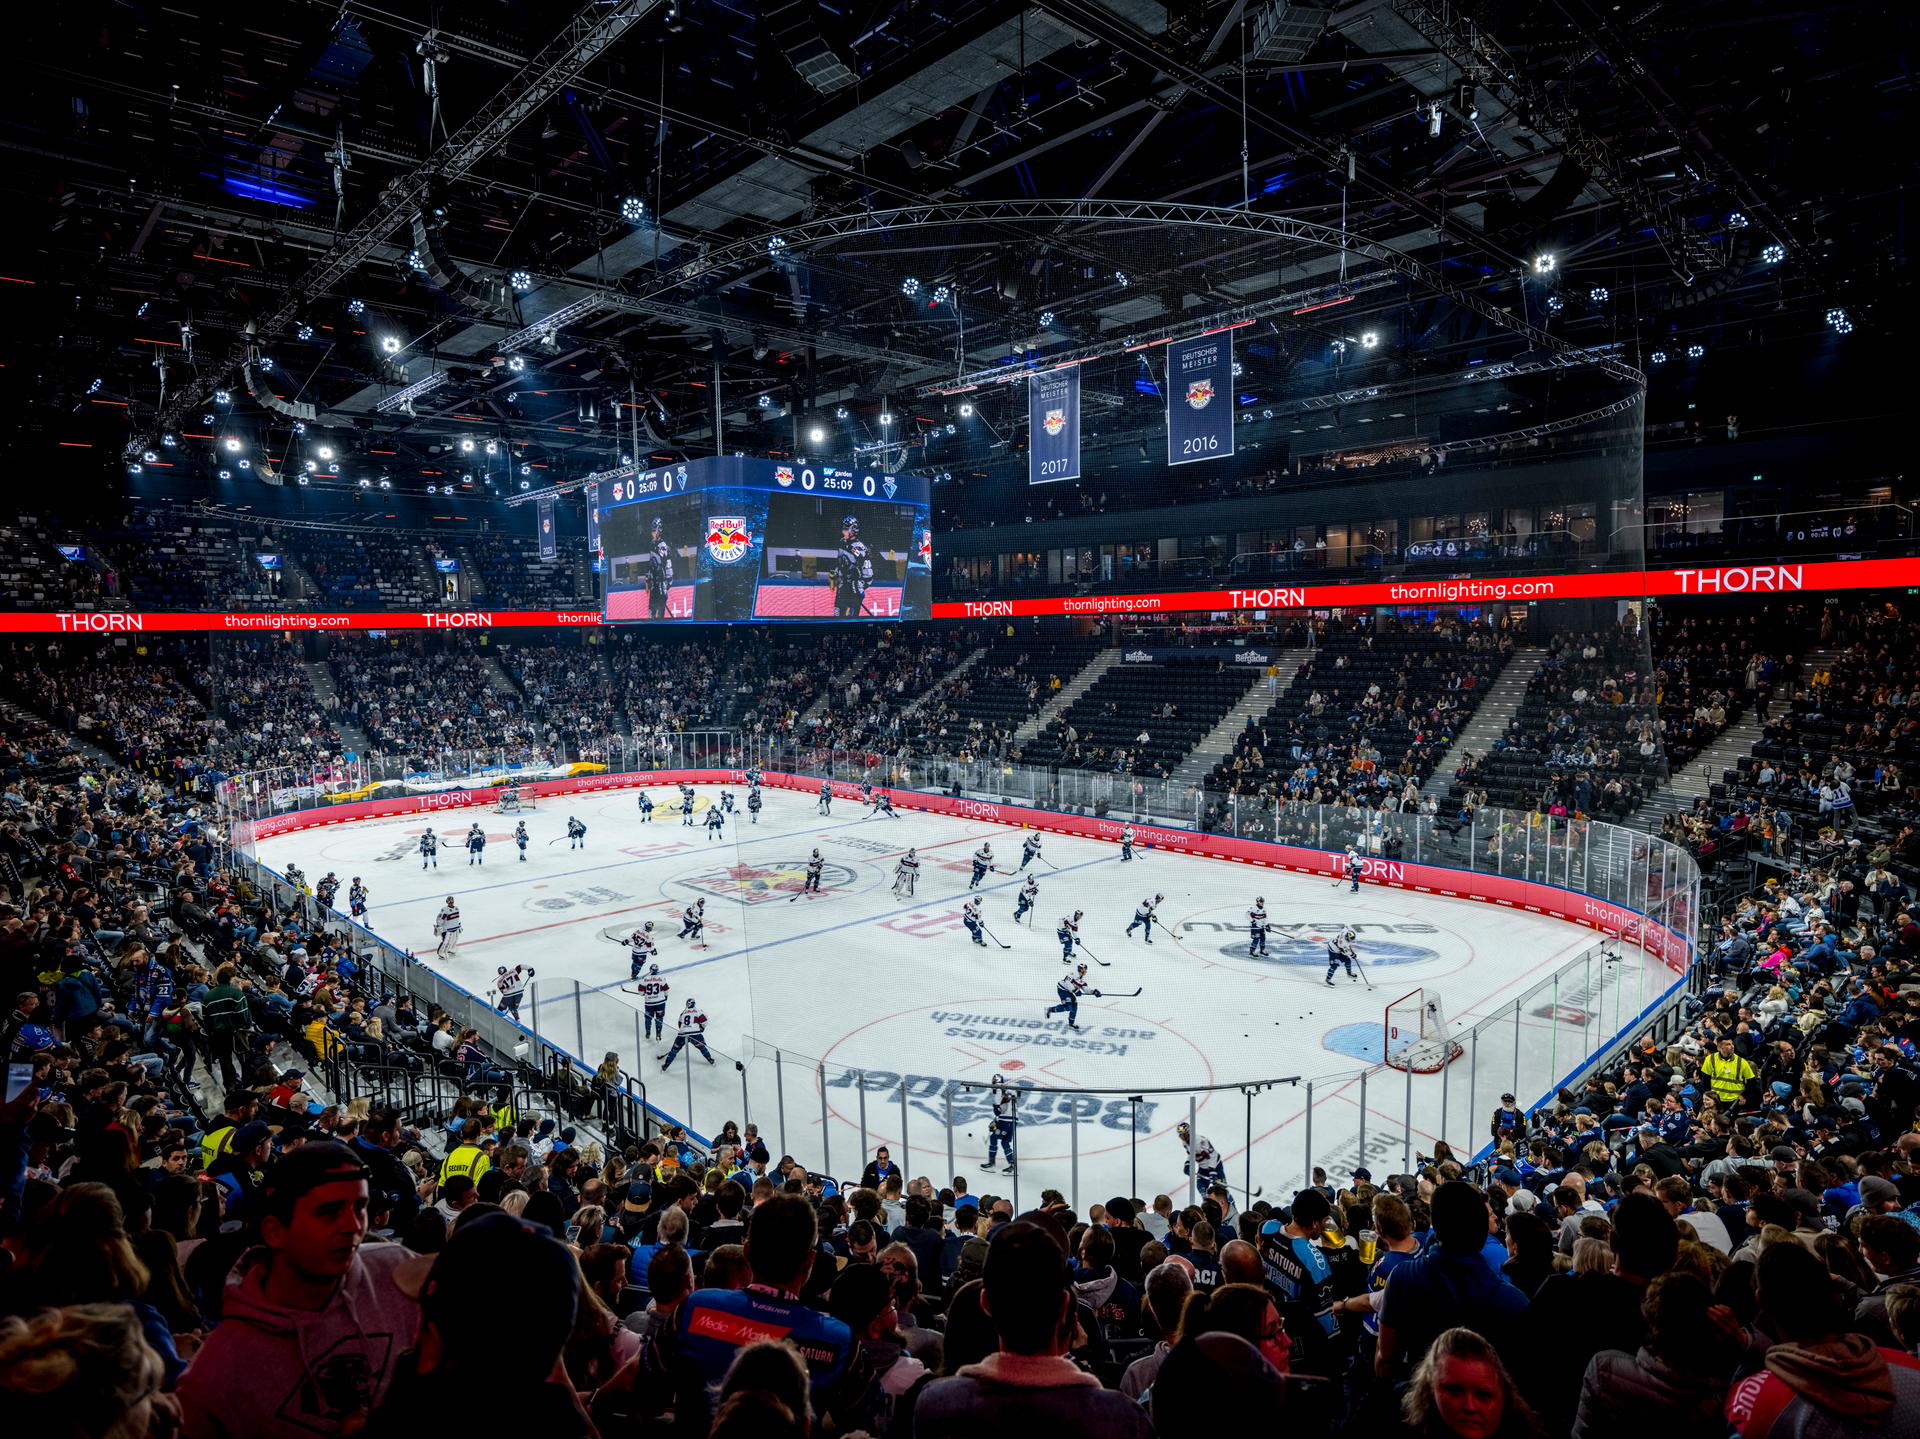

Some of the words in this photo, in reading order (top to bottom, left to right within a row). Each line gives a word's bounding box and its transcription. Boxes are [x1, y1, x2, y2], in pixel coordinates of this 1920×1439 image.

[1182, 347, 1217, 361] DEUTSCHER
[1182, 355, 1218, 370] MEISTER
[1041, 380, 1068, 392] DEUTSCHER
[1041, 388, 1068, 398] MEISTER
[1184, 435, 1218, 454] 2016
[1041, 459, 1068, 475] 2017
[627, 480, 634, 499] 0
[639, 481, 657, 493] 25:09
[663, 472, 672, 492] 0
[802, 469, 815, 490] 0
[824, 478, 853, 489] 25:09
[863, 476, 875, 496] 0
[711, 520, 725, 528] Red
[726, 520, 743, 529] Bull
[1674, 565, 1803, 593] THORN
[1390, 579, 1554, 600] thornlighting.com
[1064, 597, 1161, 612] thornlighting.com
[1229, 588, 1304, 608] THORN
[964, 601, 1013, 616] THORN
[56, 614, 143, 631] THORN
[224, 614, 350, 629] thornlighting.com
[422, 613, 492, 627] THORN
[1126, 652, 1153, 663] Bergader
[1235, 652, 1268, 664] Bergader
[577, 773, 653, 788] thornlighting.com
[418, 792, 472, 807] THORN
[958, 800, 998, 817] THORN
[503, 975, 514, 988] 17
[646, 983, 660, 995] 93
[158, 986, 169, 995] 22
[684, 1015, 691, 1025] 8
[930, 1010, 1094, 1036] Alpenmilch
[945, 1026, 1129, 1056] Käsegenuss
[1102, 1026, 1157, 1041] aus
[1269, 1247, 1302, 1279] SATURN
[800, 1346, 834, 1363] SATURN
